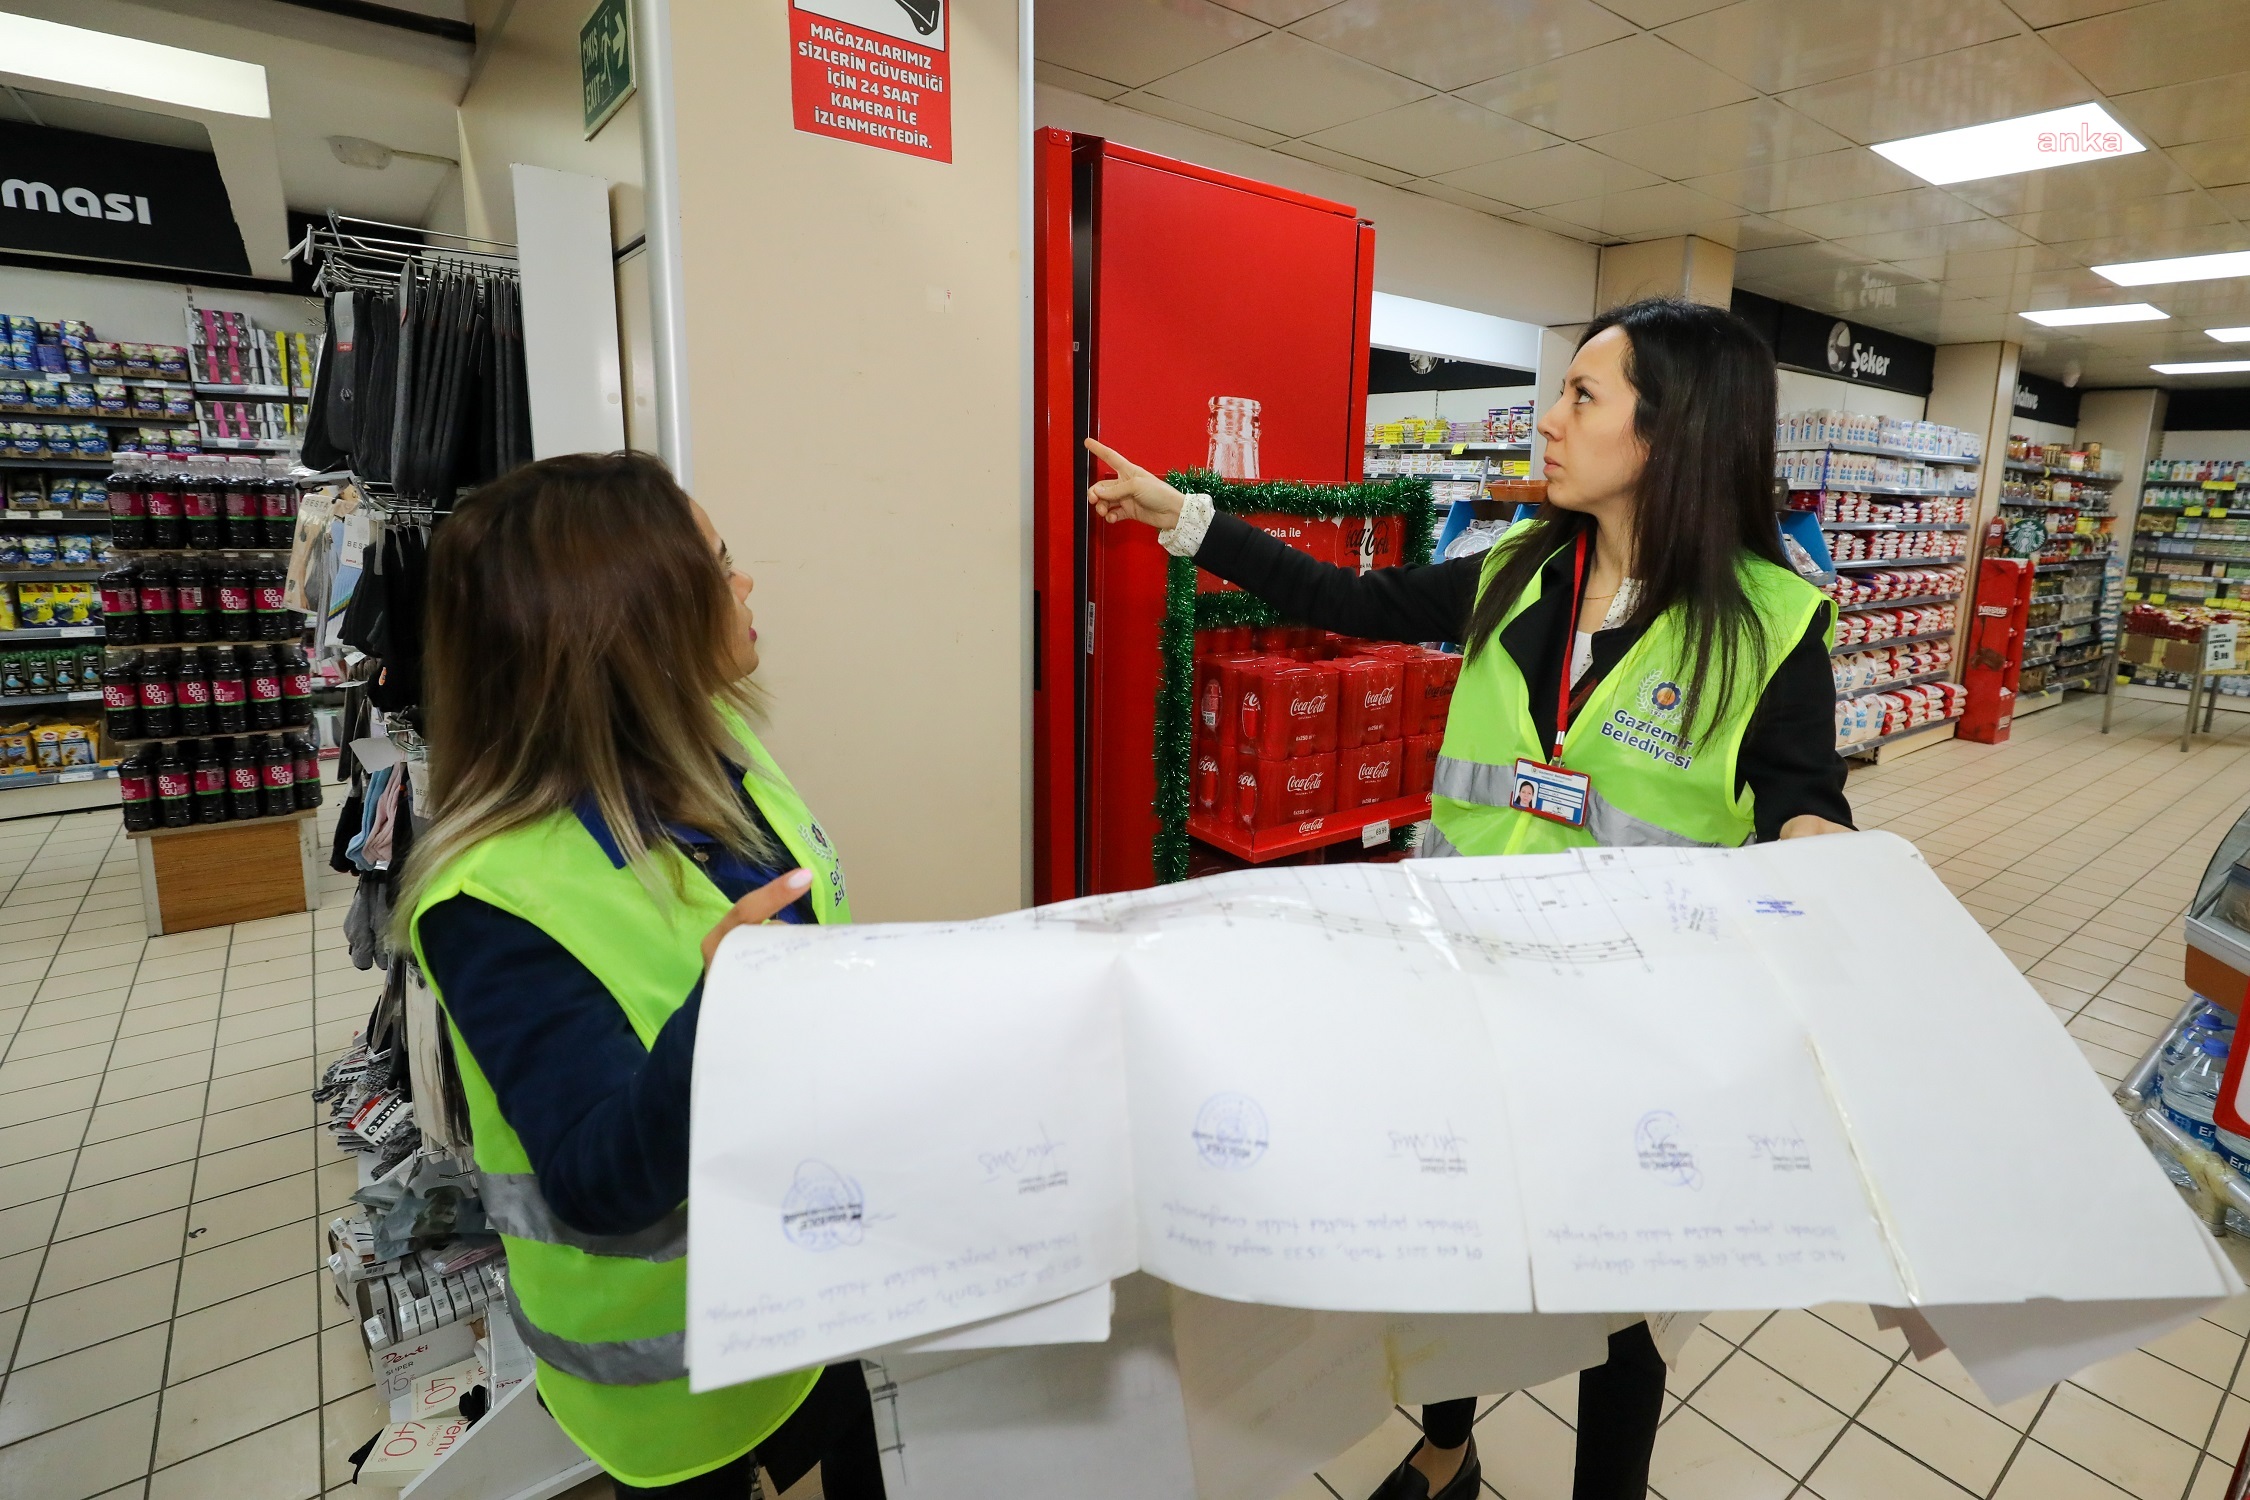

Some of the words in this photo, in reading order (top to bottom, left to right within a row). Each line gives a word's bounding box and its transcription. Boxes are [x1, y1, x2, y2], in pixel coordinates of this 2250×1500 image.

[810, 23, 932, 70] MAĞAZALARIMIZ
[798, 41, 866, 72] SİZLERİN
[870, 60, 943, 93] GÜVENLİĞİ
[586, 72, 600, 115] EXIT
[827, 67, 857, 90] İÇİN
[860, 79, 879, 96] 24
[882, 87, 919, 106] SAAT
[831, 92, 894, 120] KAMERA
[897, 105, 917, 126] İLE
[815, 106, 933, 149] İZLENMEKTEDİR.
[1851, 342, 1890, 378] Şeker
[347, 541, 368, 550] BEST
[1289, 528, 1301, 538] ile
[1290, 694, 1328, 716] Coca-Cola
[1365, 686, 1395, 708] Coca-Cola
[1601, 721, 1693, 770] Belediyesi
[1614, 709, 1693, 750] Gaziemr
[1287, 772, 1324, 792] Coca-Cola
[1358, 761, 1390, 780] Coca-Cola
[1299, 818, 1324, 833] Coca-Cola
[381, 1371, 409, 1395] 15
[384, 1421, 426, 1457] 40
